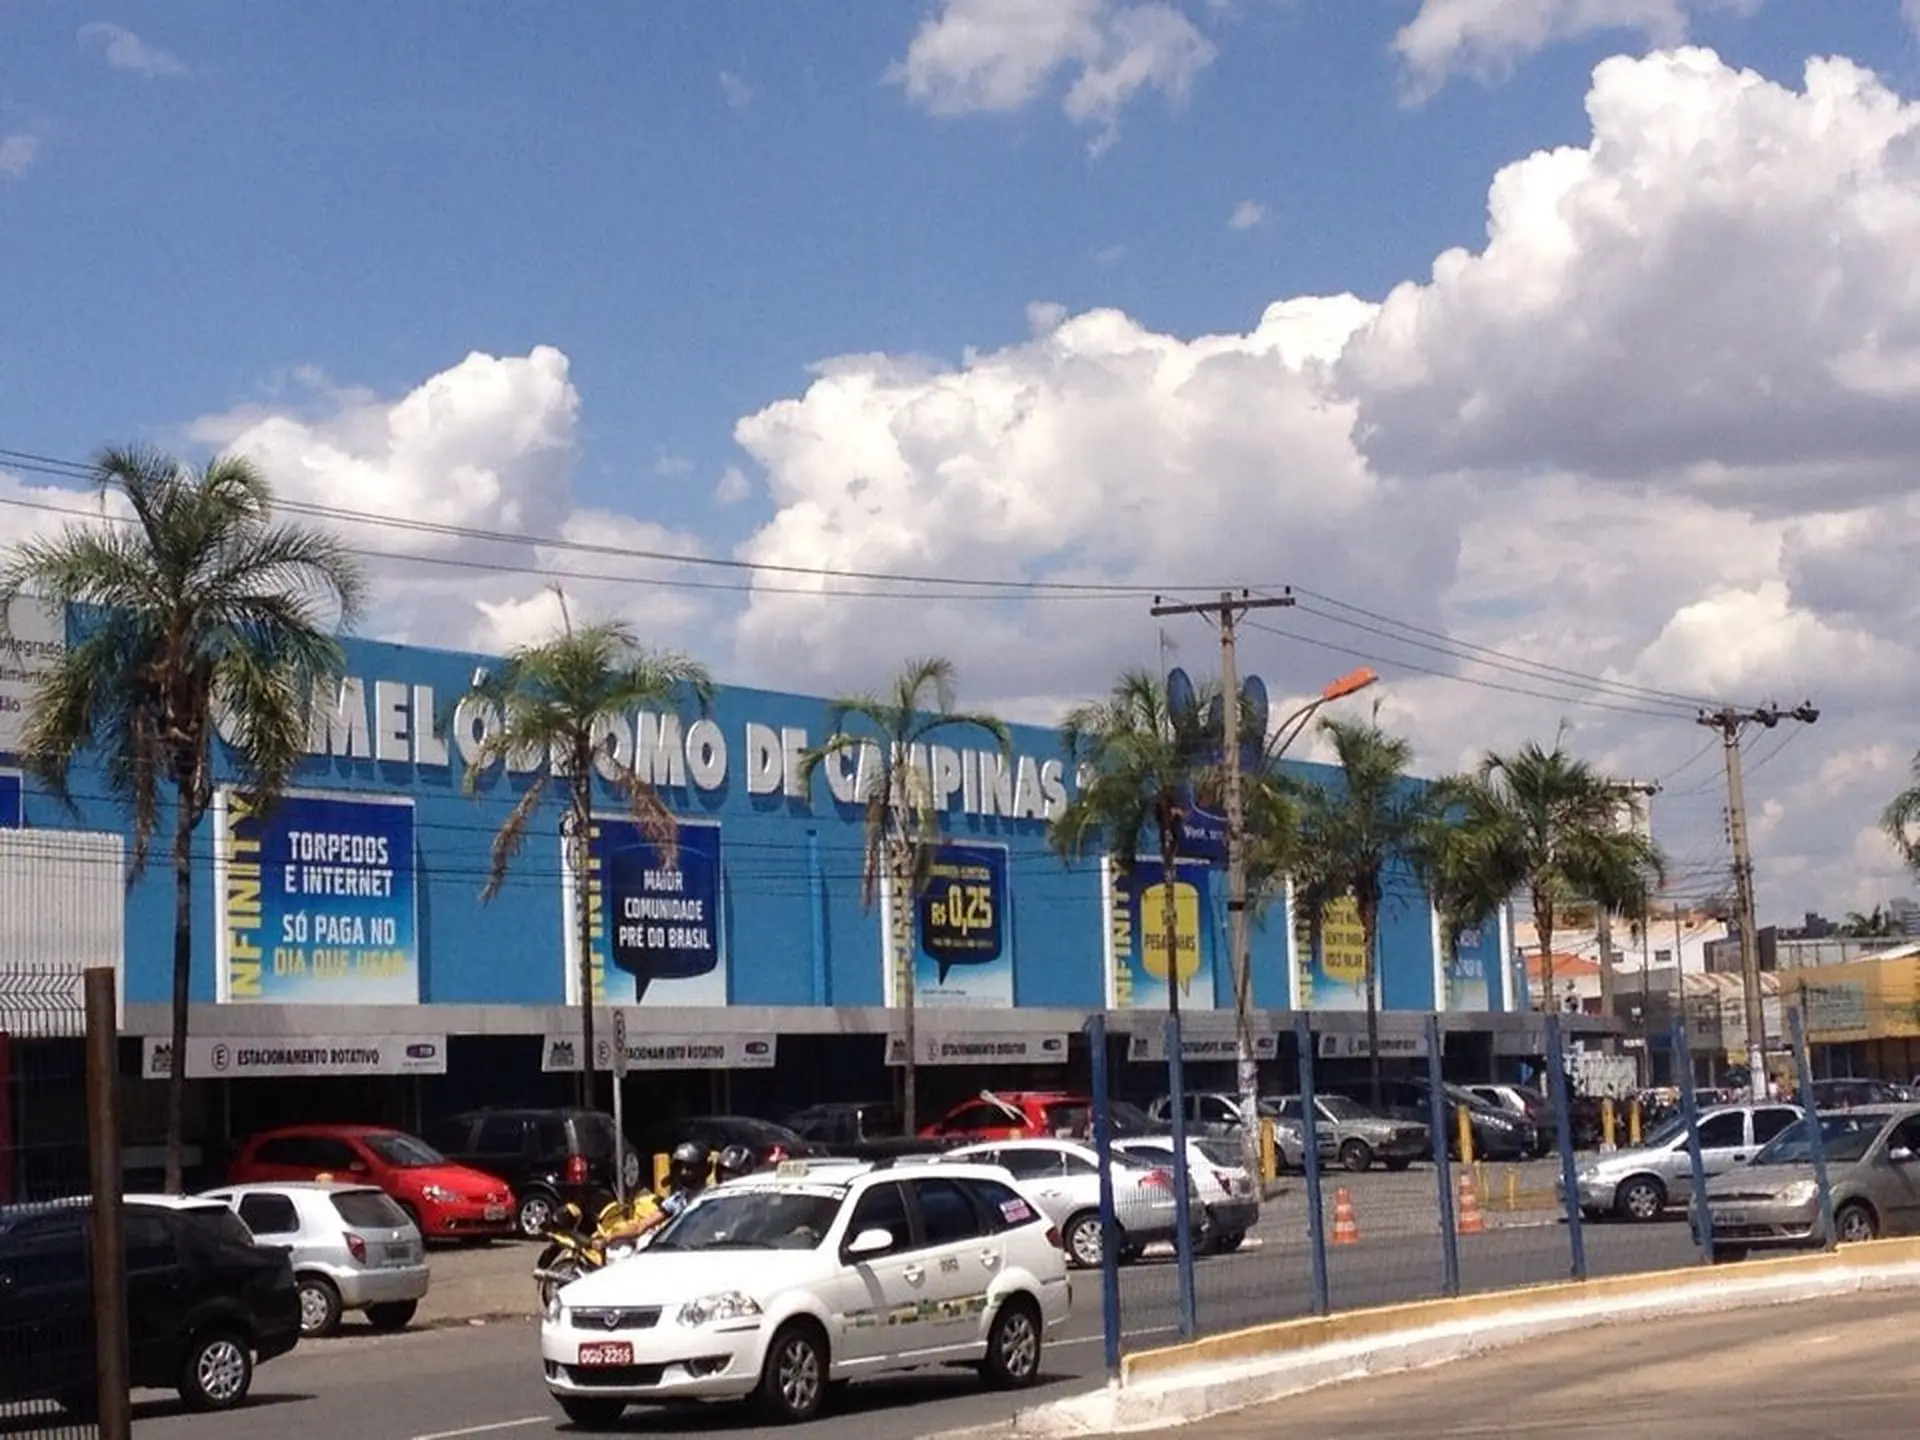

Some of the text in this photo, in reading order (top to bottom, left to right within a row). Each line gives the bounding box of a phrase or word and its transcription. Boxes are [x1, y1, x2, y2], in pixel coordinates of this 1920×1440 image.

[746, 721, 808, 800] DE
[824, 736, 1069, 821] CAMPINAS
[287, 831, 389, 865] TORPEDOS
[284, 865, 394, 897] E INTERNET
[643, 870, 684, 891] MAIOR
[624, 897, 704, 920] COMUNIDADE
[948, 884, 993, 937] 0,25
[282, 910, 396, 945] SÓ PAGA NO
[619, 925, 711, 949] PRÉ DO BRASIL
[274, 946, 306, 976] DIA
[312, 947, 350, 977] QUE
[237, 1049, 327, 1066] ESTACIONAMENTO
[330, 1048, 380, 1065] ROTATIVO
